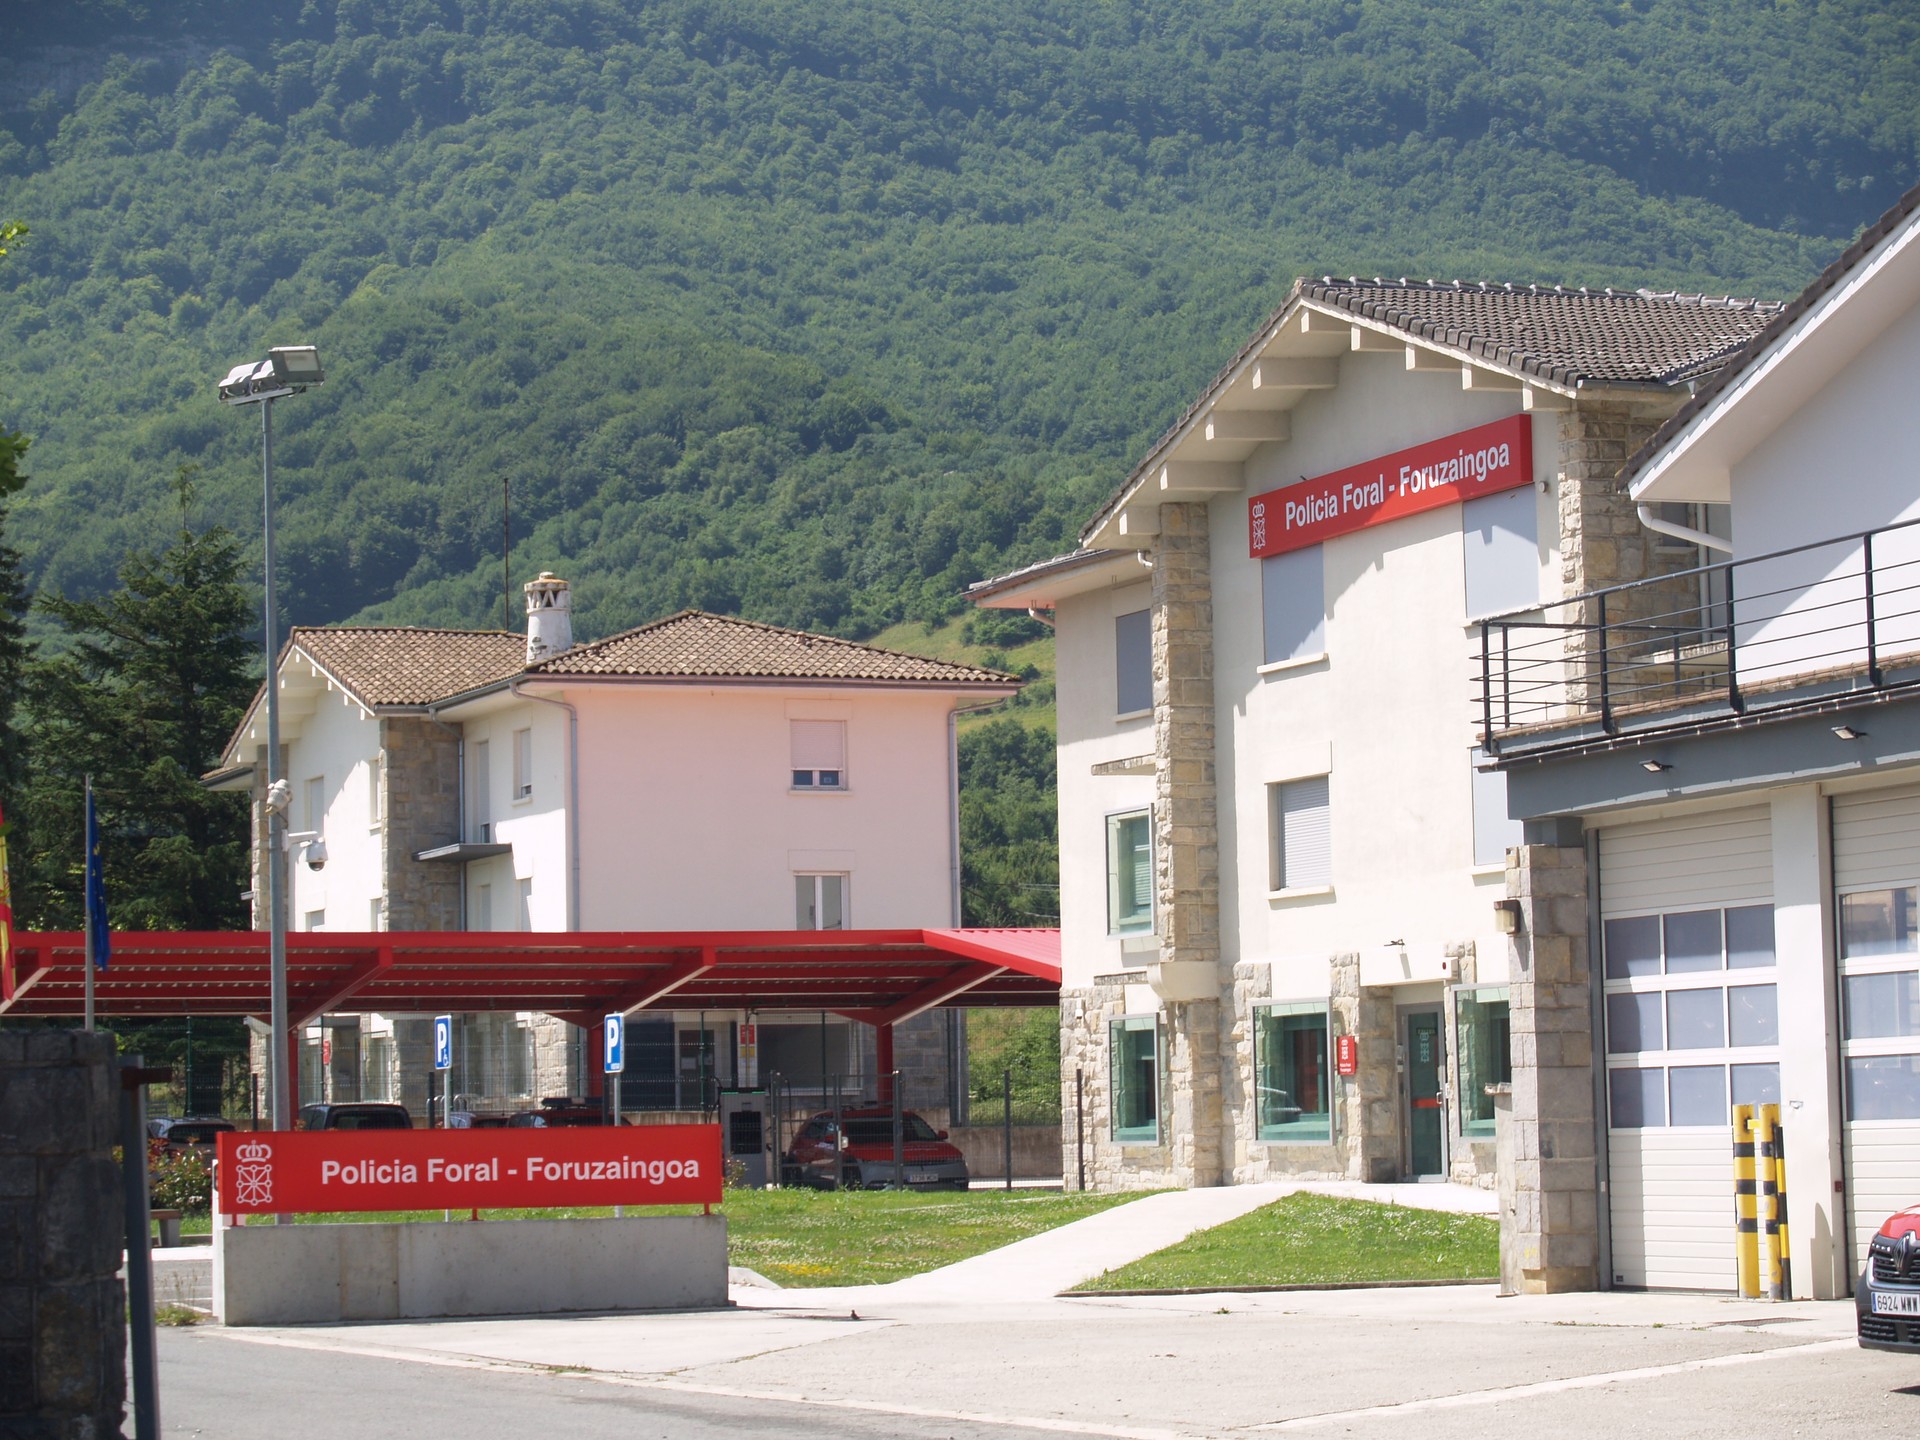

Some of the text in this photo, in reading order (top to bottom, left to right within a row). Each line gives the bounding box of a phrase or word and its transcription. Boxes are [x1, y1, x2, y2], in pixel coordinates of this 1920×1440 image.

[1285, 490, 1338, 530] Policia
[1342, 473, 1384, 514] Foral
[1399, 443, 1510, 498] Foruzaingoa
[437, 1023, 447, 1063] P
[607, 1019, 619, 1064] P
[321, 1159, 417, 1185] Policia
[427, 1157, 499, 1183] Foral
[527, 1155, 700, 1185] Foruzaingoa
